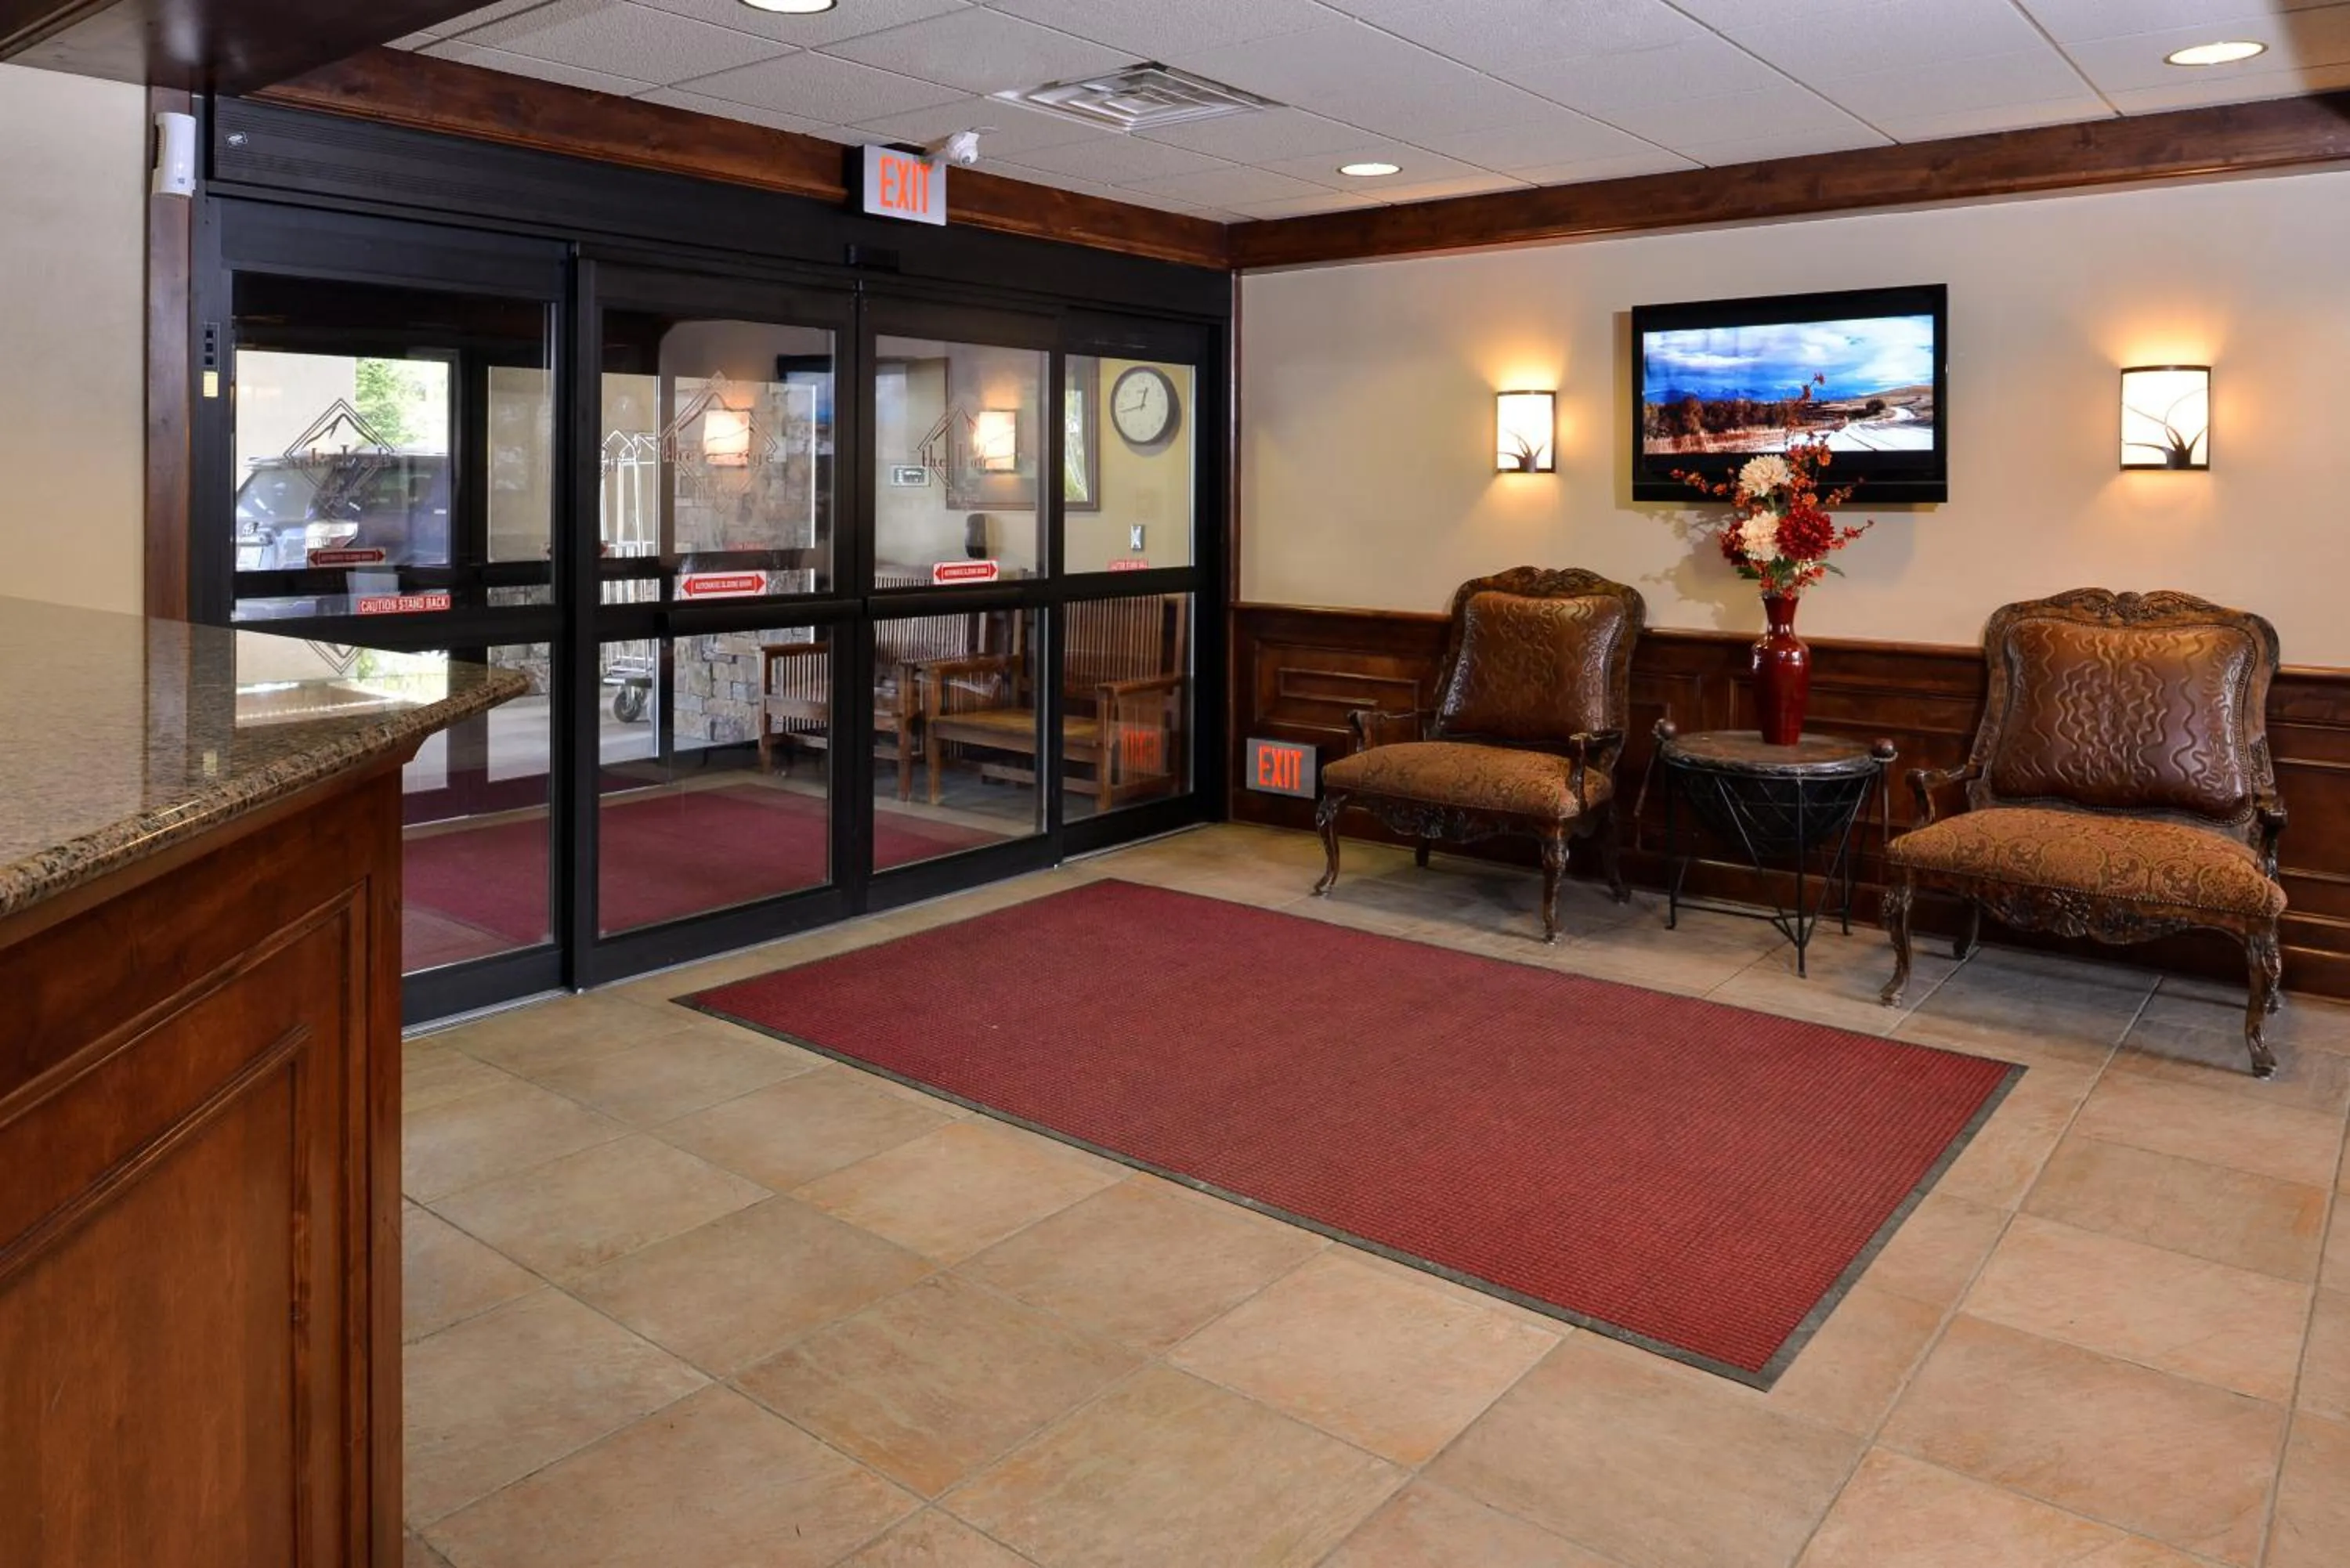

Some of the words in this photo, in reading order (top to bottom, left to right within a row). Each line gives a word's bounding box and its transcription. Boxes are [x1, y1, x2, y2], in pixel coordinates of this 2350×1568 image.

[879, 156, 932, 214] EXIT
[361, 598, 396, 612] CAUTION
[399, 597, 424, 610] STAND
[426, 595, 446, 609] BACK
[1257, 745, 1303, 790] EXIT
